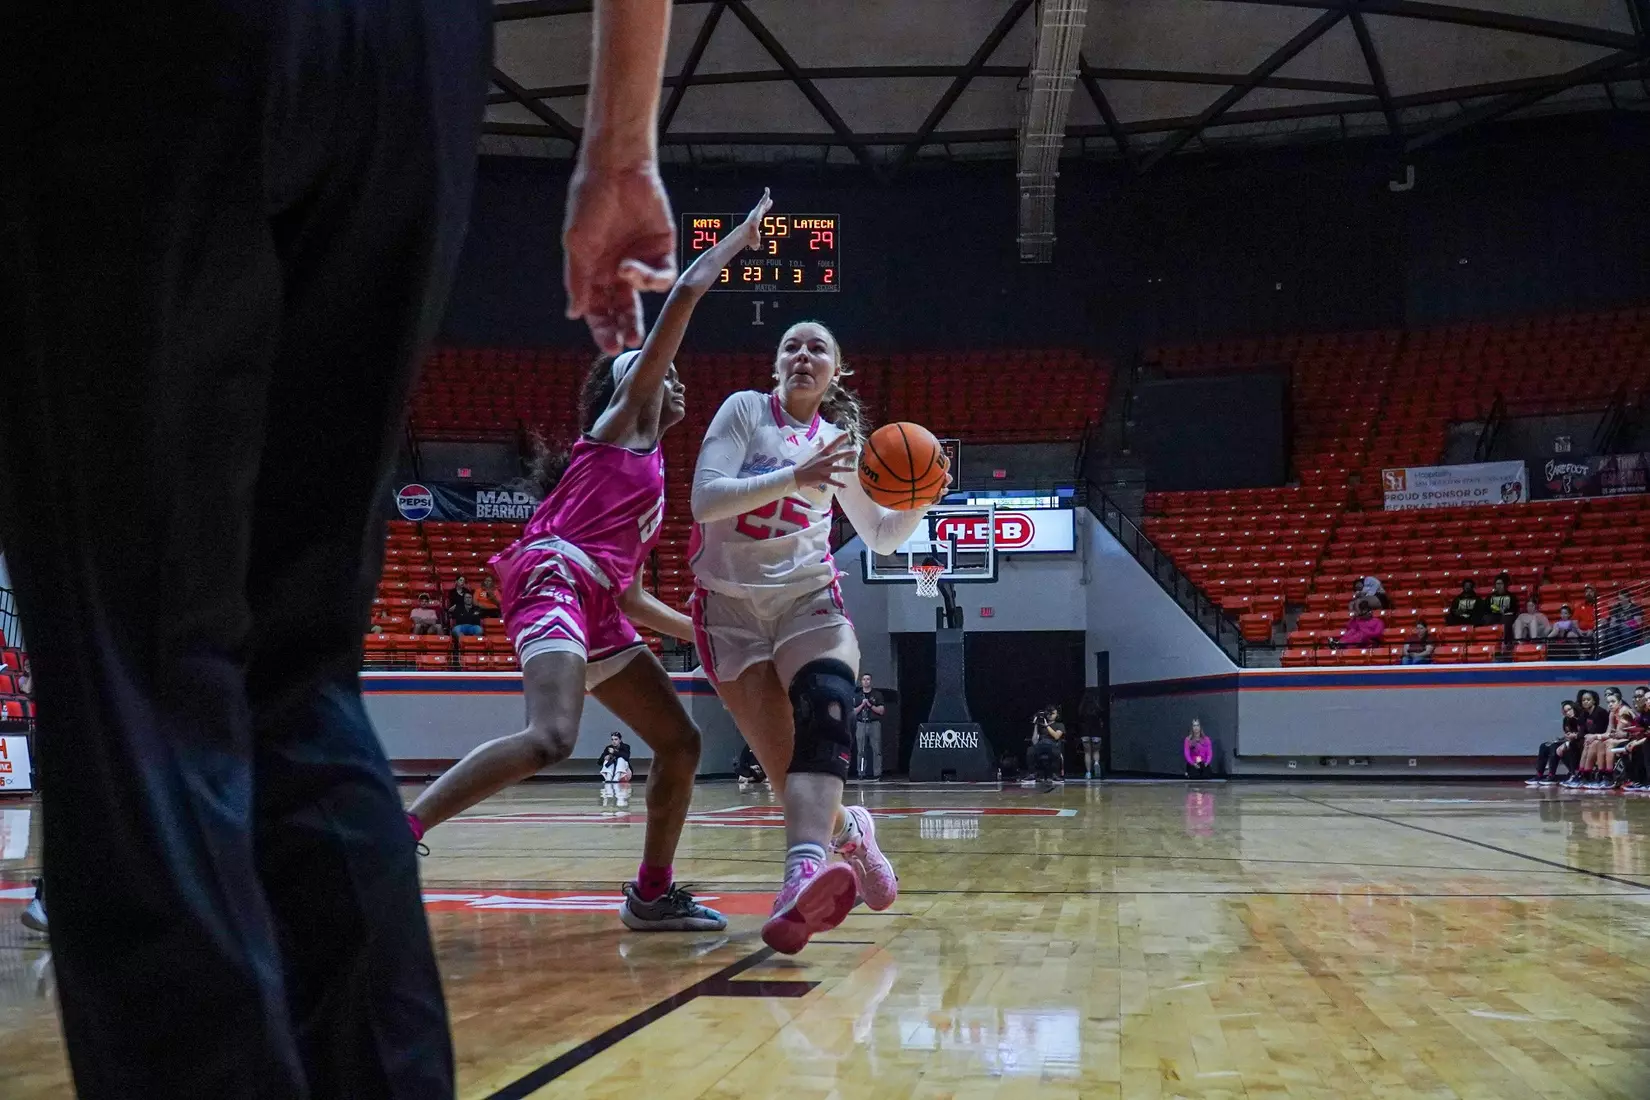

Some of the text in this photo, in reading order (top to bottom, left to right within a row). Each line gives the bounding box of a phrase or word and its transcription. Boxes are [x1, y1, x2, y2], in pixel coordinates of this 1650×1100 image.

[693, 218, 720, 228] KATS
[793, 219, 834, 229] LATECH
[693, 230, 717, 249] 24
[809, 230, 833, 250] 29
[767, 240, 777, 255] 3
[739, 258, 783, 267] PLAYER FOUL
[720, 268, 729, 283] 3
[743, 266, 762, 282] 23
[773, 267, 780, 281] 1
[793, 268, 802, 283] 3
[823, 268, 834, 283] 2
[399, 497, 432, 507] PEPSI
[1384, 487, 1489, 502] PROUD SPONSOR OF
[476, 503, 531, 519] BEARKAT
[945, 522, 1022, 541] H-E-B
[919, 729, 979, 742] MEMORIAL
[919, 739, 978, 749] HERMANN
